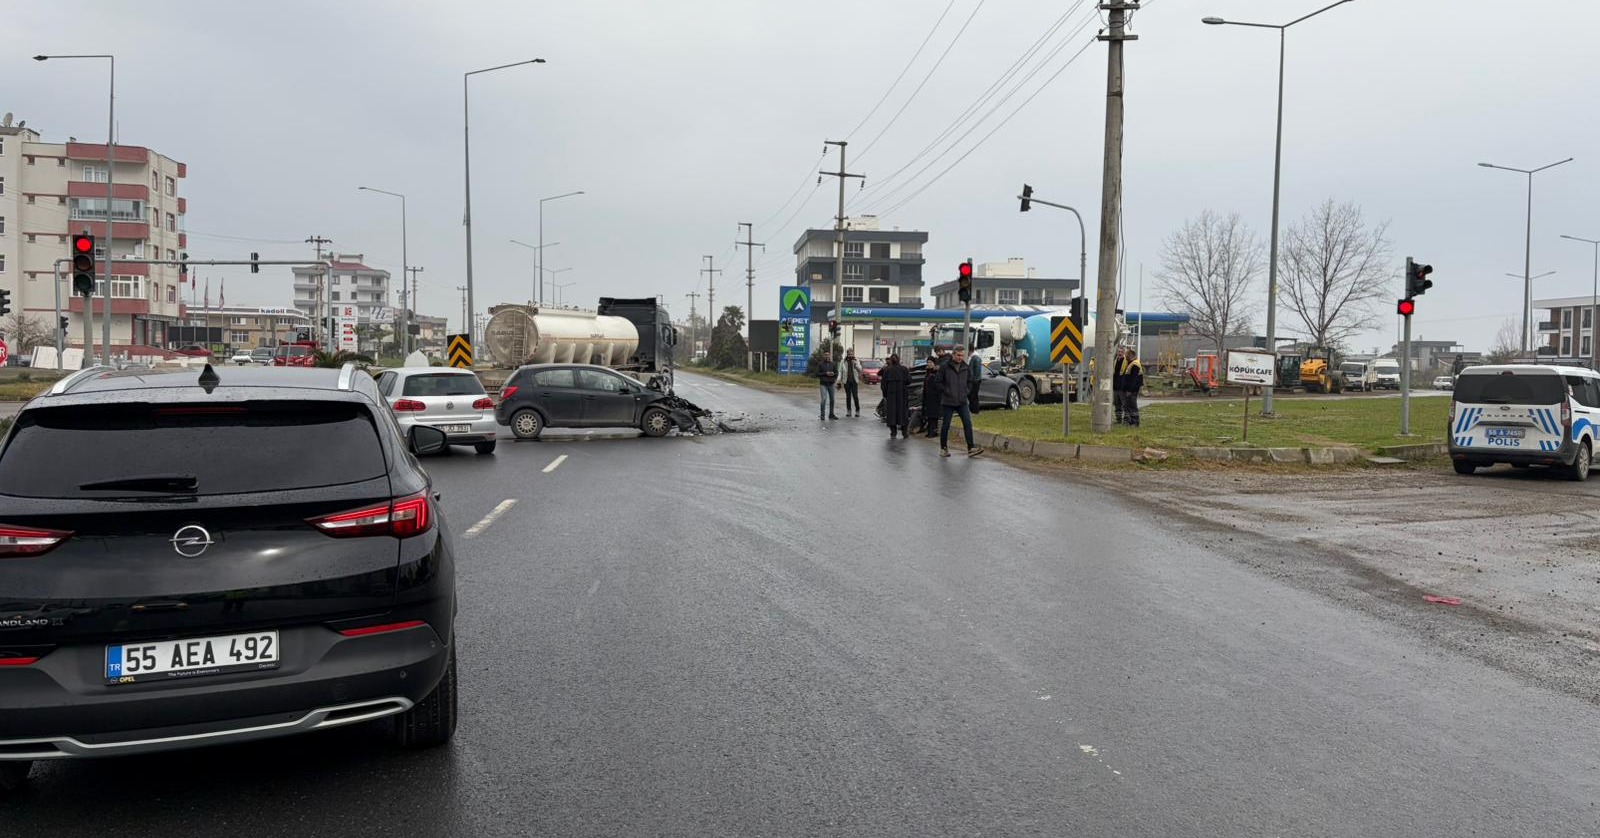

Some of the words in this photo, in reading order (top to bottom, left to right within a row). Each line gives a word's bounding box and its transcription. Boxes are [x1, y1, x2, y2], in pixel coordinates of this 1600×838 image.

[1229, 365, 1255, 375] KÖPÜK
[1256, 368, 1273, 376] CAFE
[127, 646, 157, 672] 55
[171, 641, 216, 668] AEA
[229, 635, 273, 662] 492
[119, 675, 136, 683] OPEL
